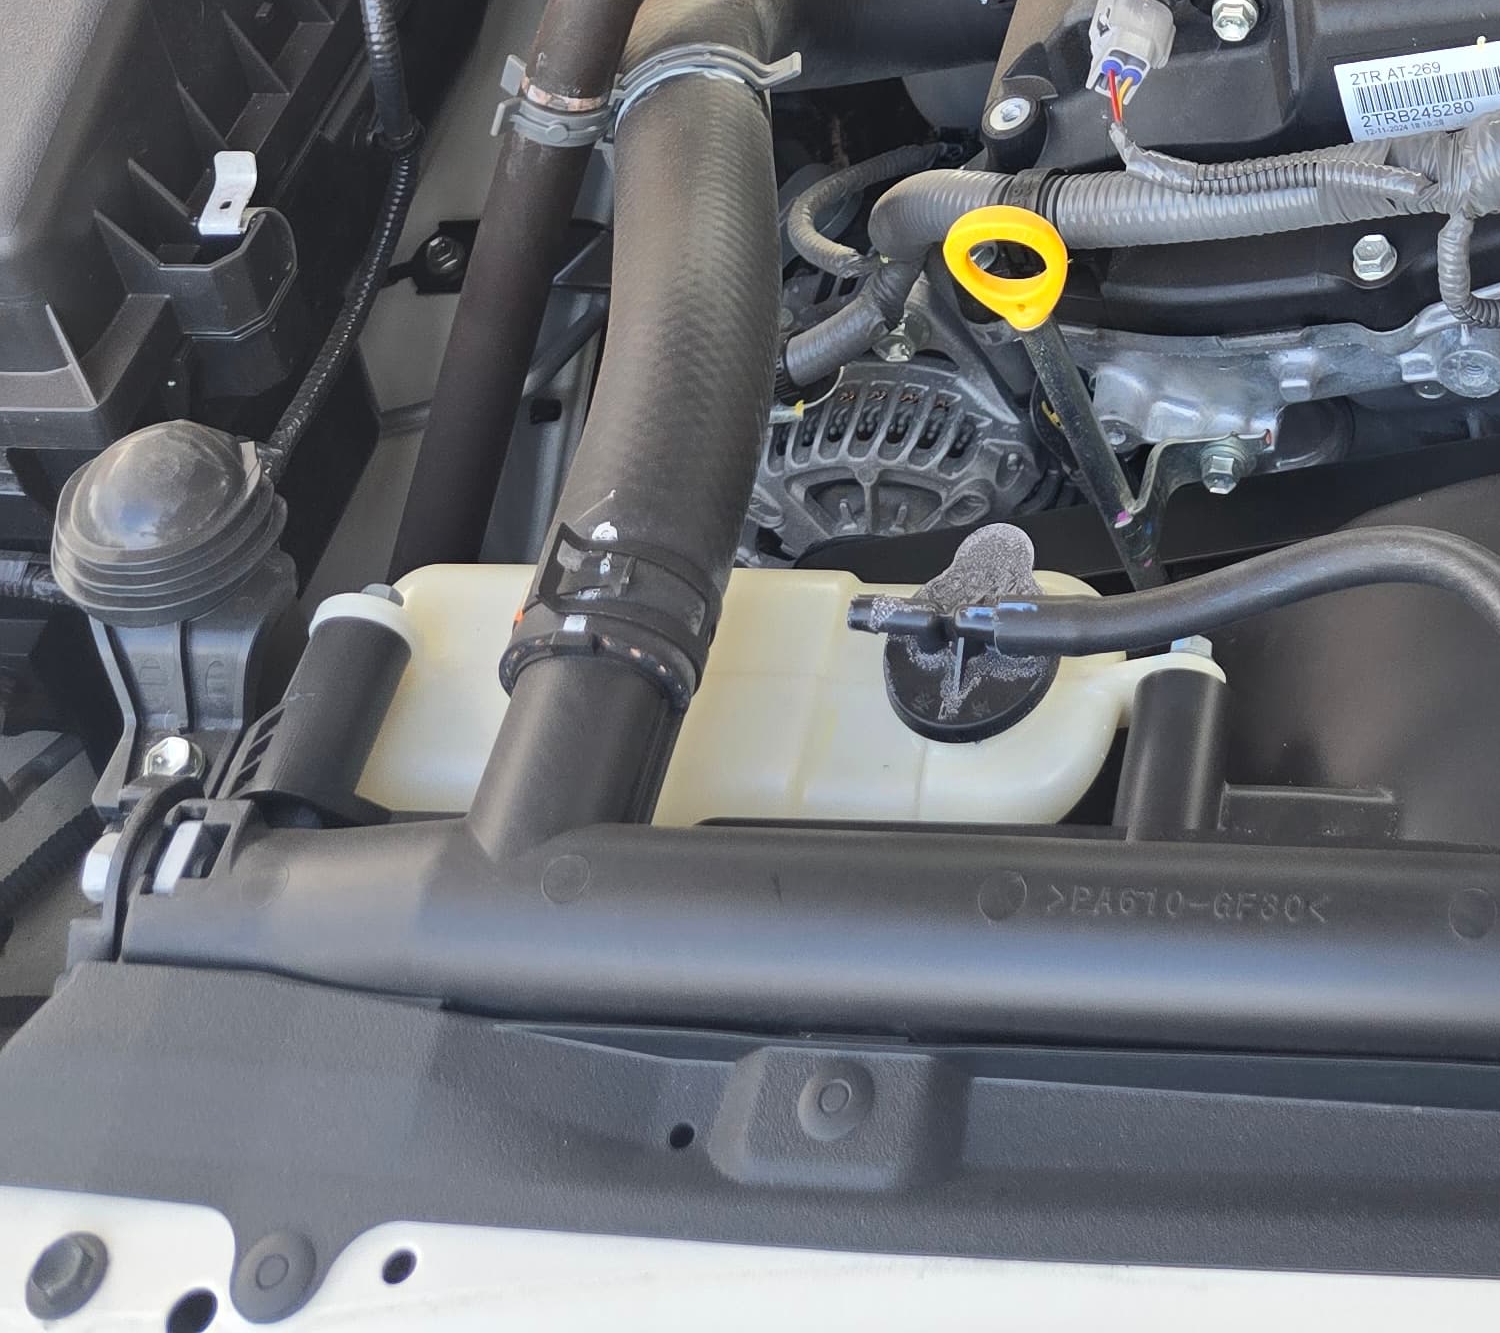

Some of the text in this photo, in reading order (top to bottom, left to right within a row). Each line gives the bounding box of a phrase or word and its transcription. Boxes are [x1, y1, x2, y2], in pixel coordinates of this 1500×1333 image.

[1350, 61, 1442, 87] 2TR AT-269
[1361, 100, 1475, 128] 2TRB245280
